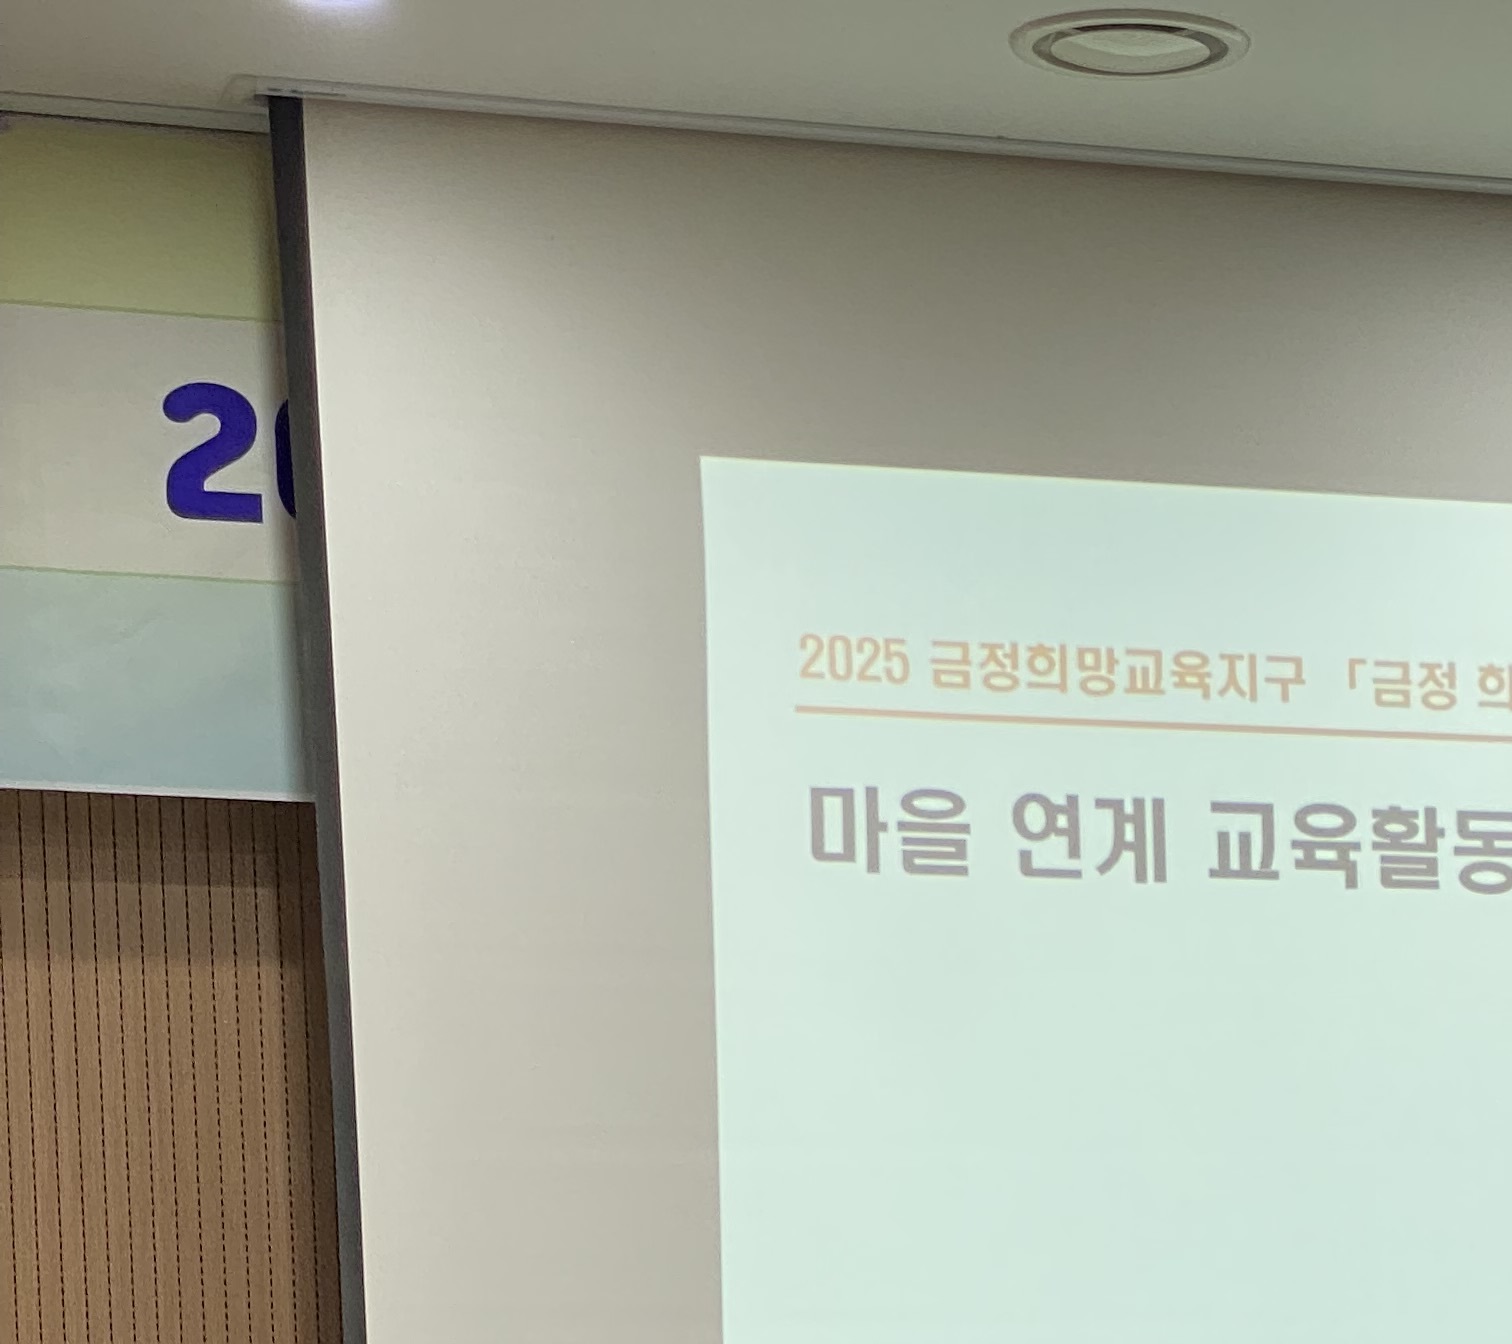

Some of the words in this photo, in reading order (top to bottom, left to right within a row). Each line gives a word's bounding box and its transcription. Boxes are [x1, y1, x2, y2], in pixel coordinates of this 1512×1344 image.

[799, 633, 911, 686] 2025
[930, 640, 1306, 704] 금정희망교육지구
[809, 785, 972, 877] 마을
[1011, 792, 1168, 884] 연계
